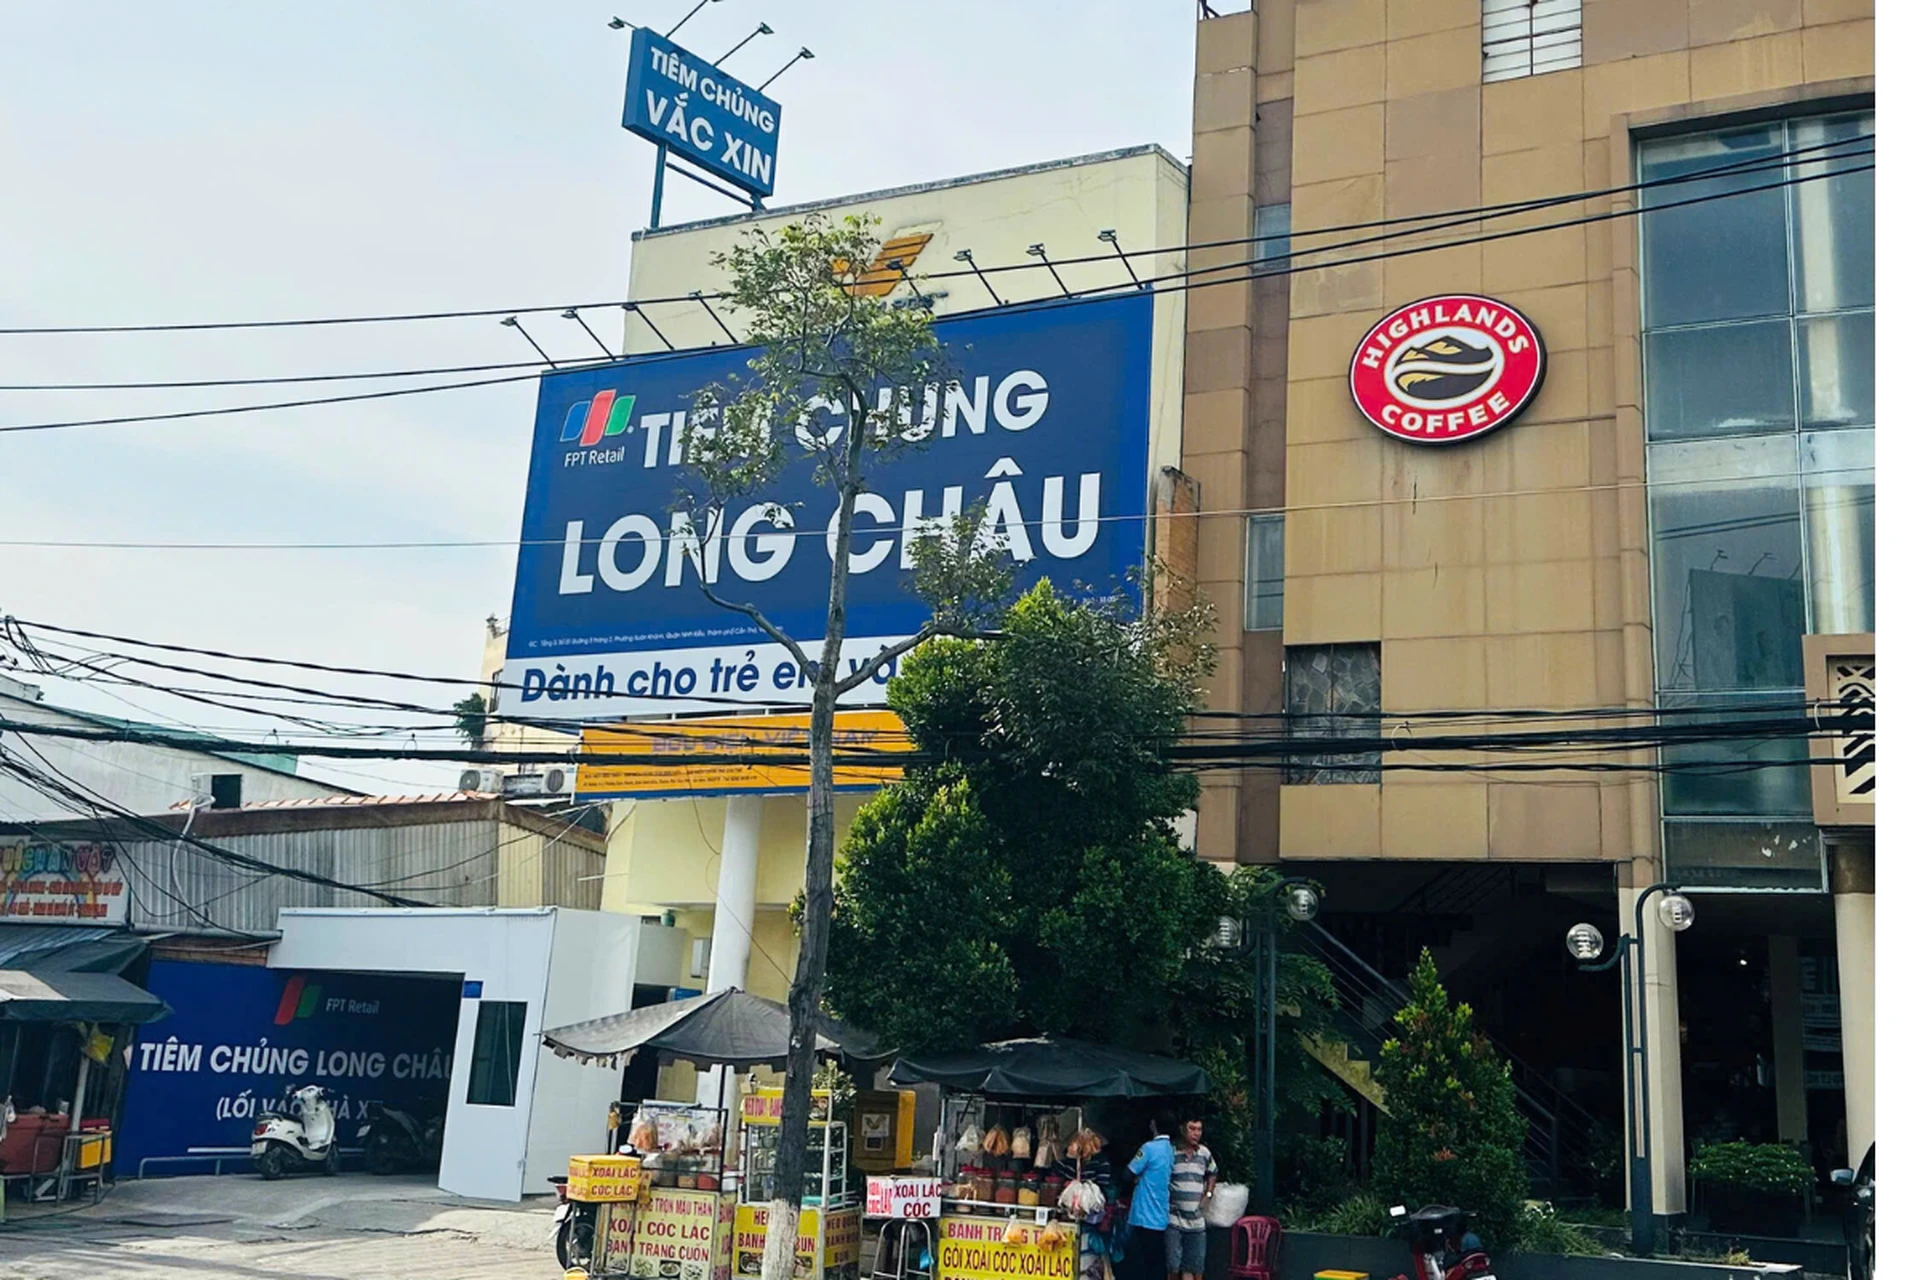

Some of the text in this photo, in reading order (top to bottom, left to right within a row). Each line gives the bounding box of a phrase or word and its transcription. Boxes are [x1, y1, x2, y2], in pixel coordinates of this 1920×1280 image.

[651, 46, 775, 134] TIÊM CHỦNG
[646, 88, 772, 185] VẮC XIN
[1361, 303, 1530, 369] HIGHLANDS
[1381, 391, 1511, 433] COFFEE
[564, 445, 625, 468] FPT Retail
[558, 456, 1101, 595] LONG CHÂU
[521, 663, 615, 702] Dành
[627, 661, 697, 697] cho
[710, 650, 759, 693] trẻ
[325, 998, 379, 1015] FPT Retail
[140, 1036, 202, 1072] TIÊM
[209, 1037, 309, 1075] CHỦNG
[316, 1050, 386, 1078] LONG
[216, 1089, 256, 1120] (LỐI
